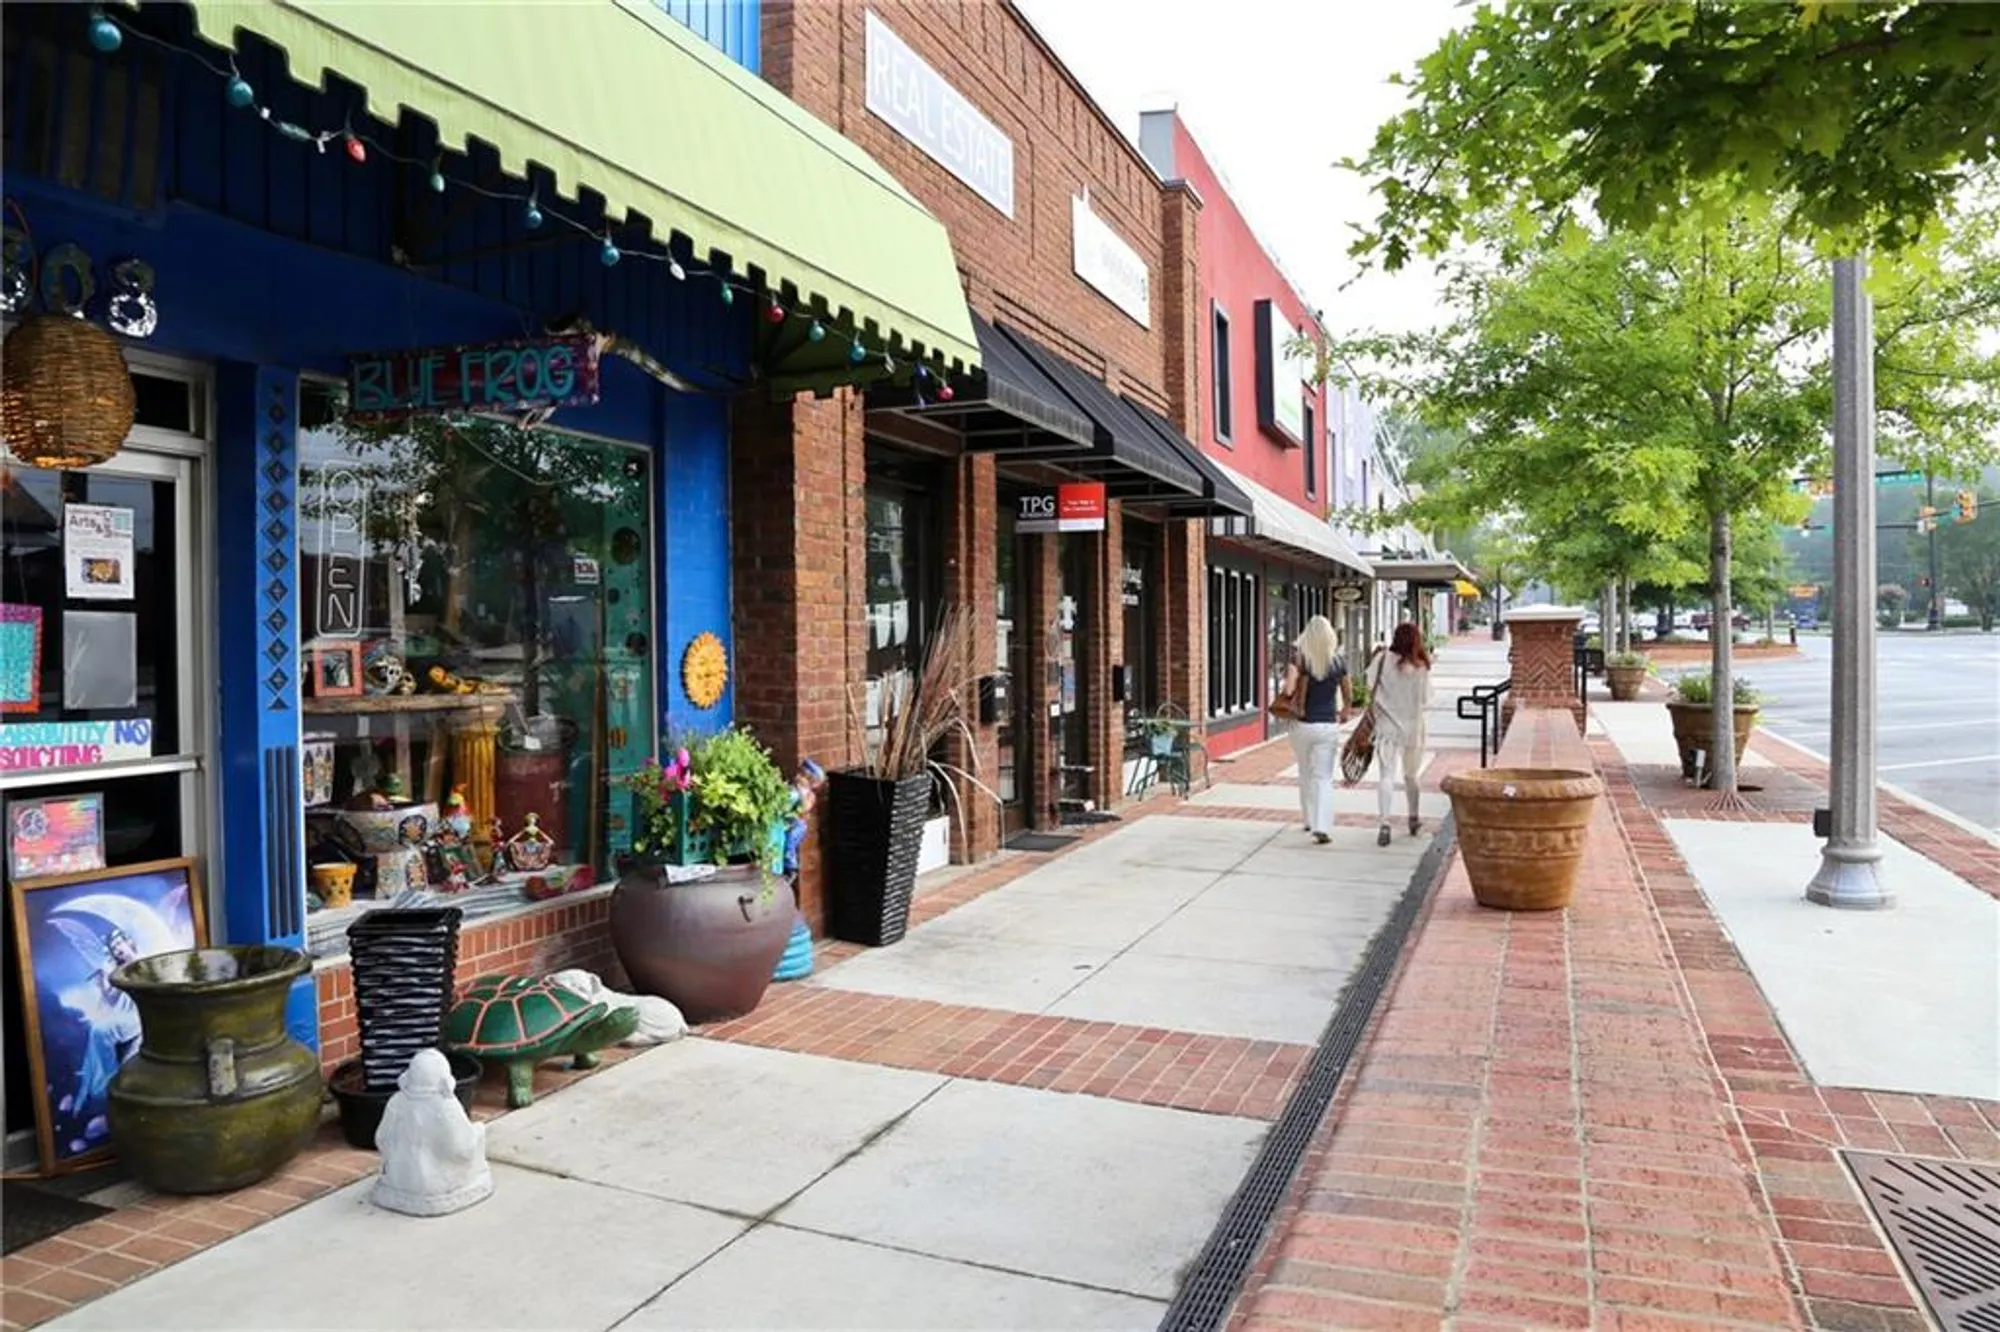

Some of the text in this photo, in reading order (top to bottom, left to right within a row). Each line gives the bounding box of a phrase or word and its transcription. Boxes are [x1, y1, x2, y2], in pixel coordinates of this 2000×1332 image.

[873, 36, 1008, 199] REAL ESTATE
[353, 344, 578, 410] BLUE FROG
[1018, 495, 1055, 513] TPG
[328, 469, 360, 629] OPEN
[114, 719, 150, 745] NO
